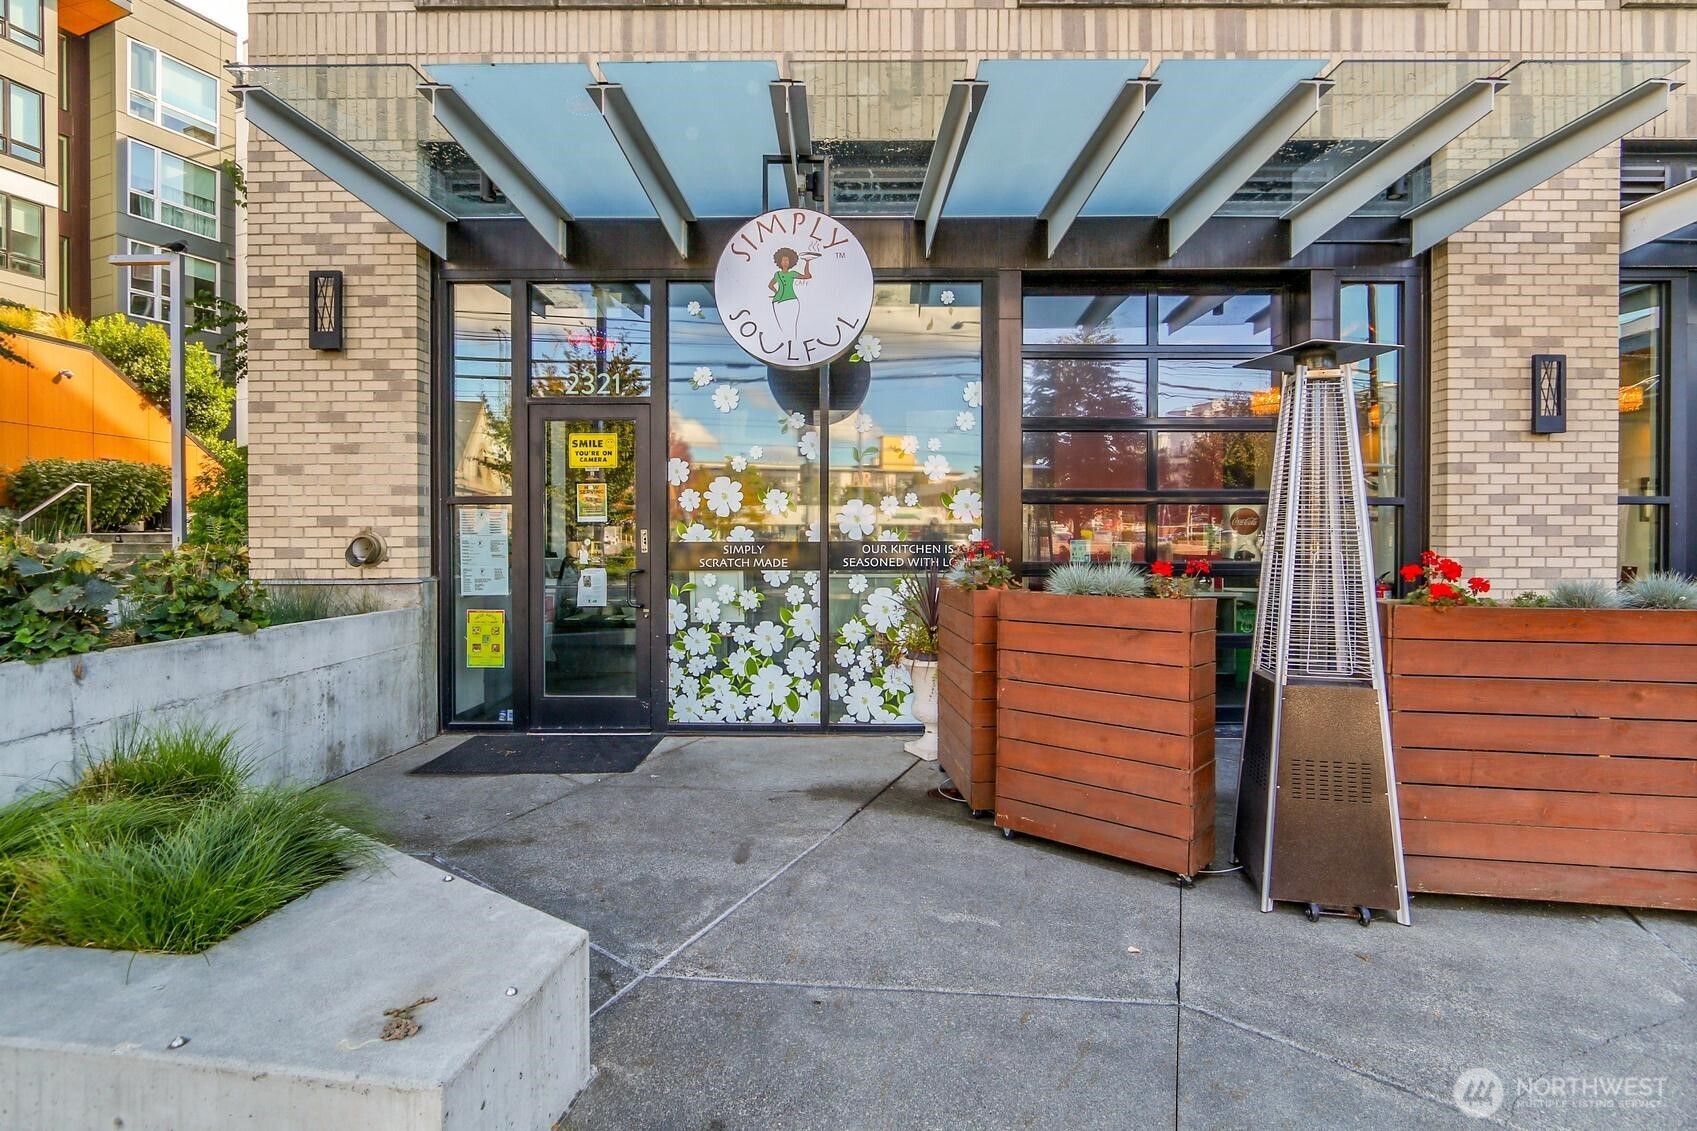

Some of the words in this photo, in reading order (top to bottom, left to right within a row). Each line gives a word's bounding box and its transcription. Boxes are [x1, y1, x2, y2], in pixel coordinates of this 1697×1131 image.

[731, 212, 849, 262] SIMPLY
[729, 309, 859, 361] SOULFUL
[565, 372, 620, 395] 2321
[572, 439, 603, 448] SMILE
[723, 545, 765, 555] SIMPLY
[862, 544, 889, 554] OUR
[891, 544, 941, 554] KITCHEN
[944, 544, 954, 554] IS
[699, 558, 751, 568] SCRATCH
[753, 558, 788, 568] MADE
[843, 557, 905, 568] SEASONED
[907, 557, 939, 568] WITH
